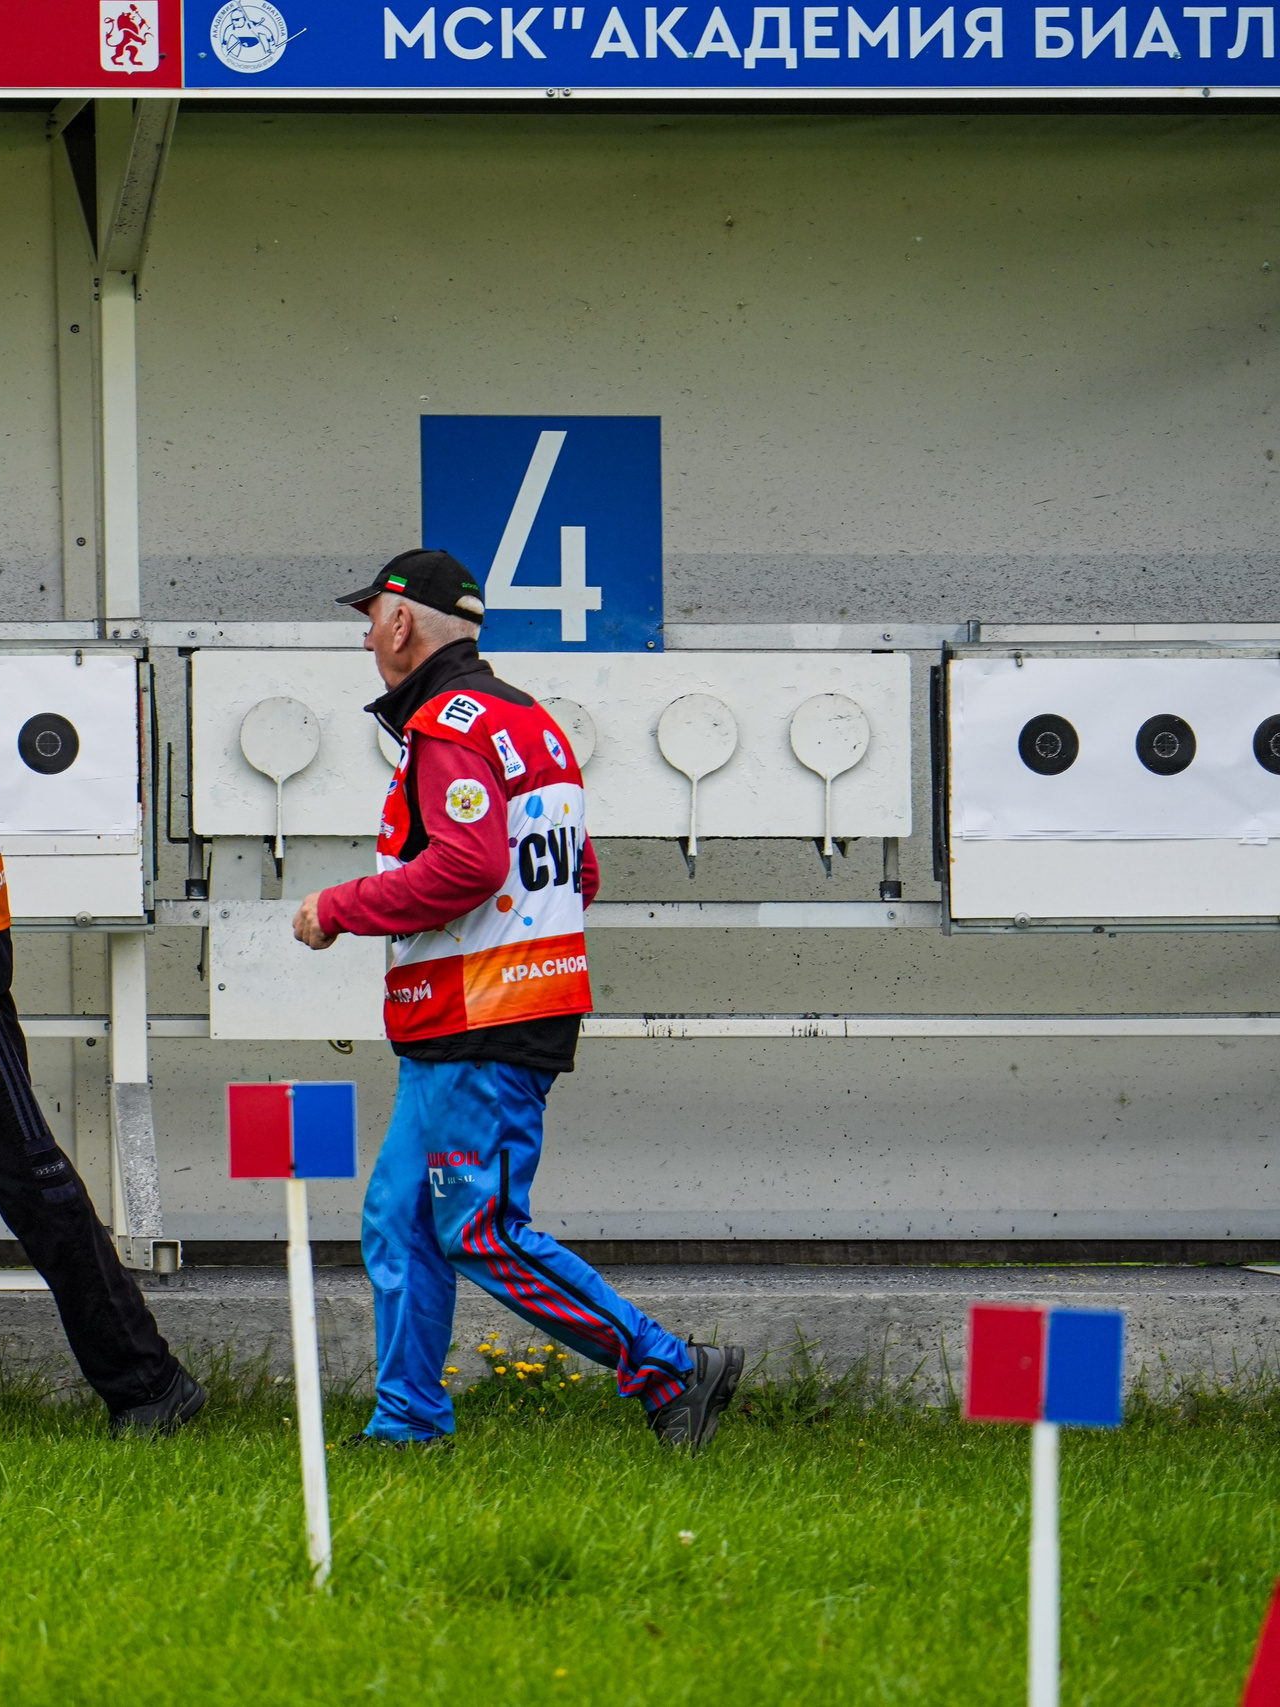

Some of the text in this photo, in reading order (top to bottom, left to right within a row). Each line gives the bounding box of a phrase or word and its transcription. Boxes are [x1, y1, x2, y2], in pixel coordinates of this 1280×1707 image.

[212, 2, 286, 38] АКАДЕМИЯ БИАТЛОНА
[1035, 6, 1275, 59] БИАТЛ
[484, 430, 602, 641] 4
